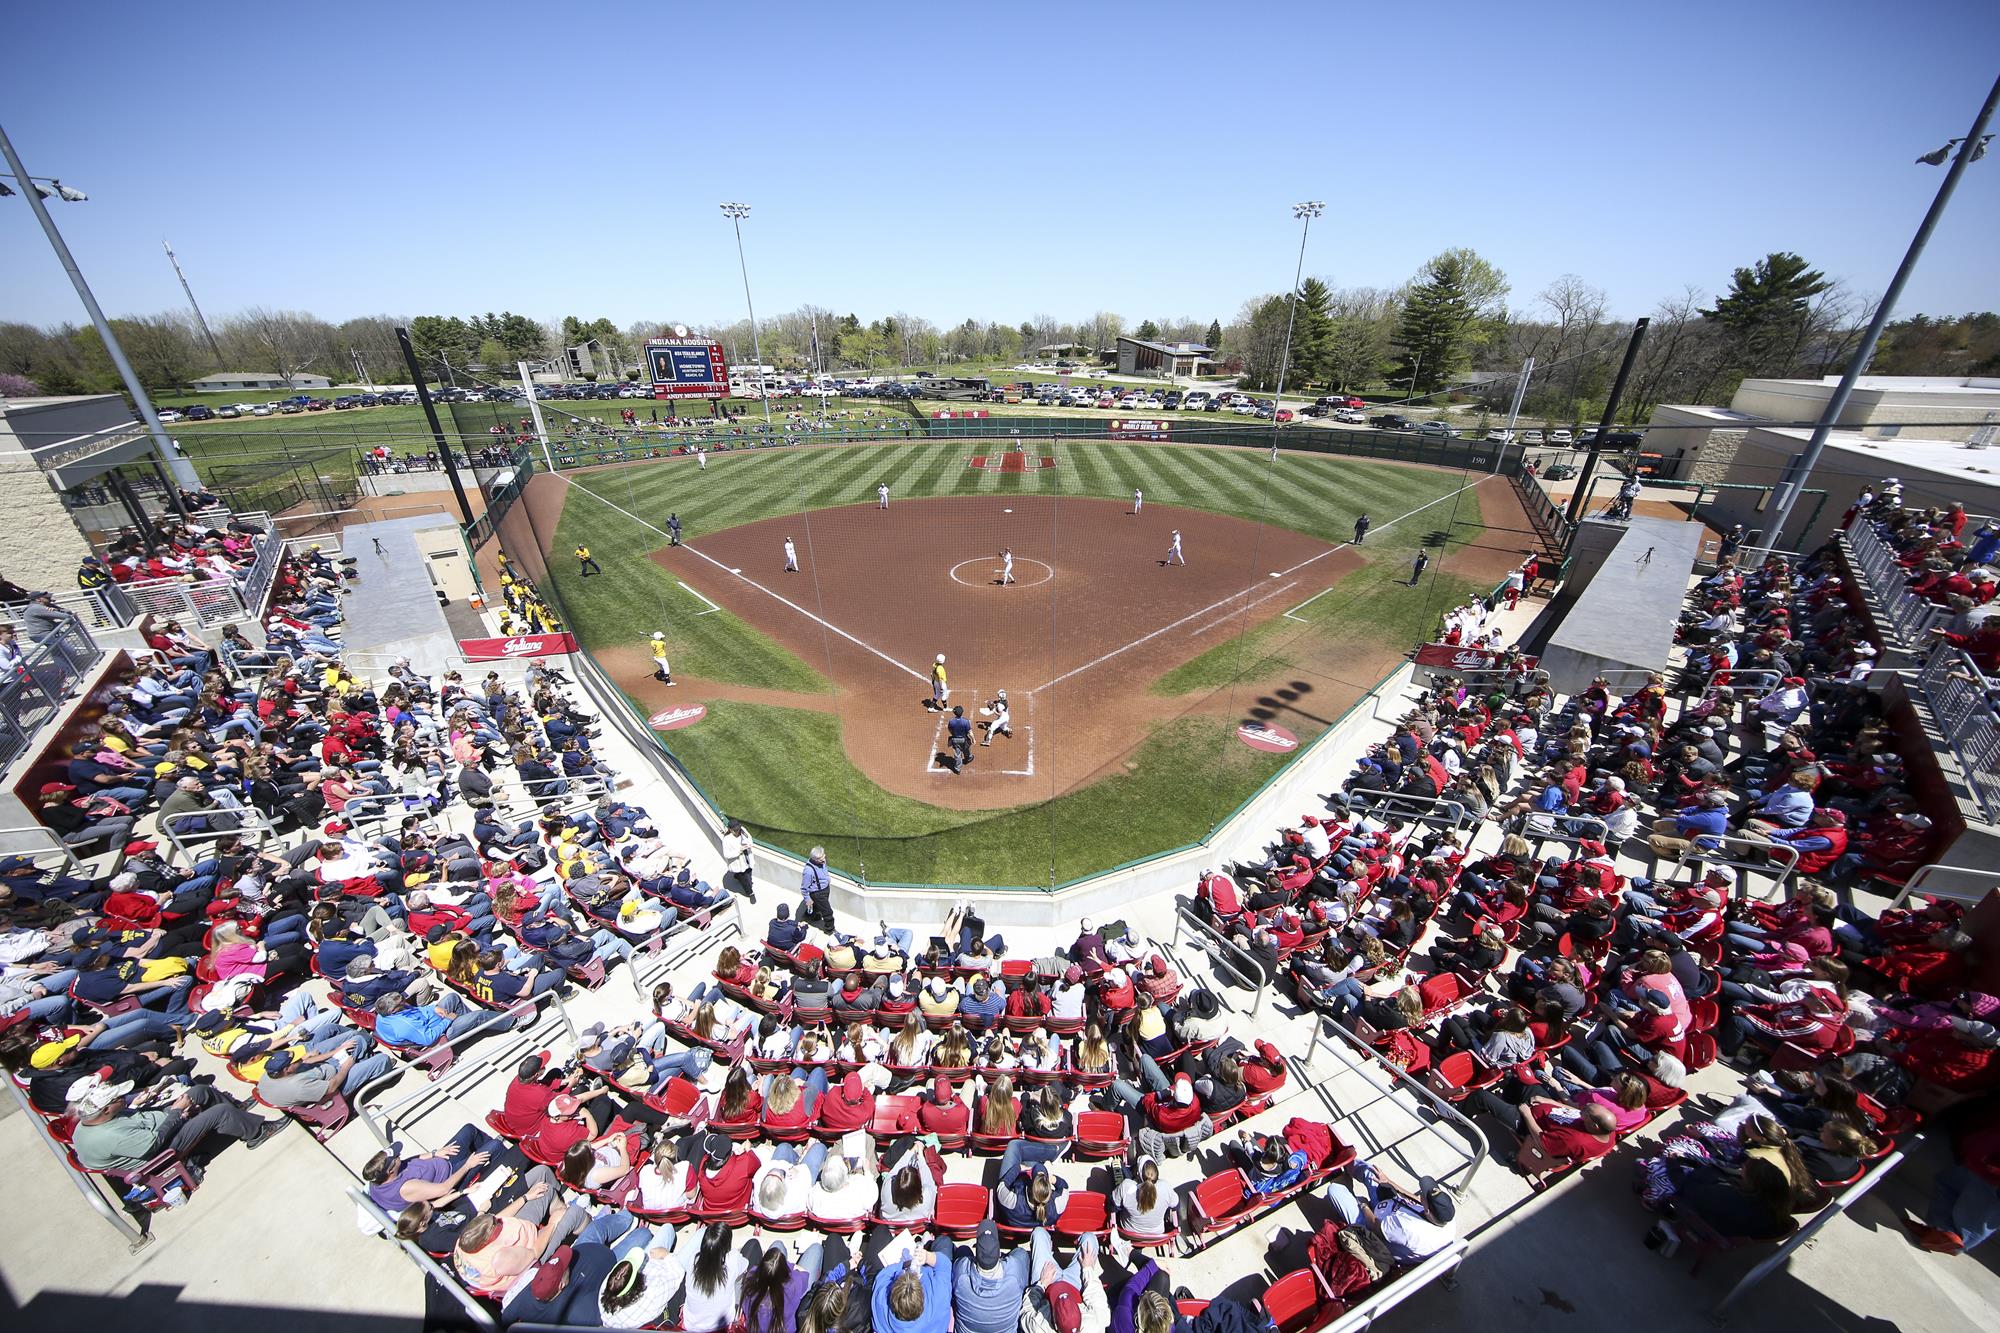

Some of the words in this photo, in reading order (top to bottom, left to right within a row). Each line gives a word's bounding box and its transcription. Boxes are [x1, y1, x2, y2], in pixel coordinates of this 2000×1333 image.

[560, 456, 574, 464] 190
[1471, 456, 1486, 464] 190
[502, 637, 543, 656] Indiana
[649, 707, 704, 726] Indiana
[1239, 725, 1296, 747] Indiana
